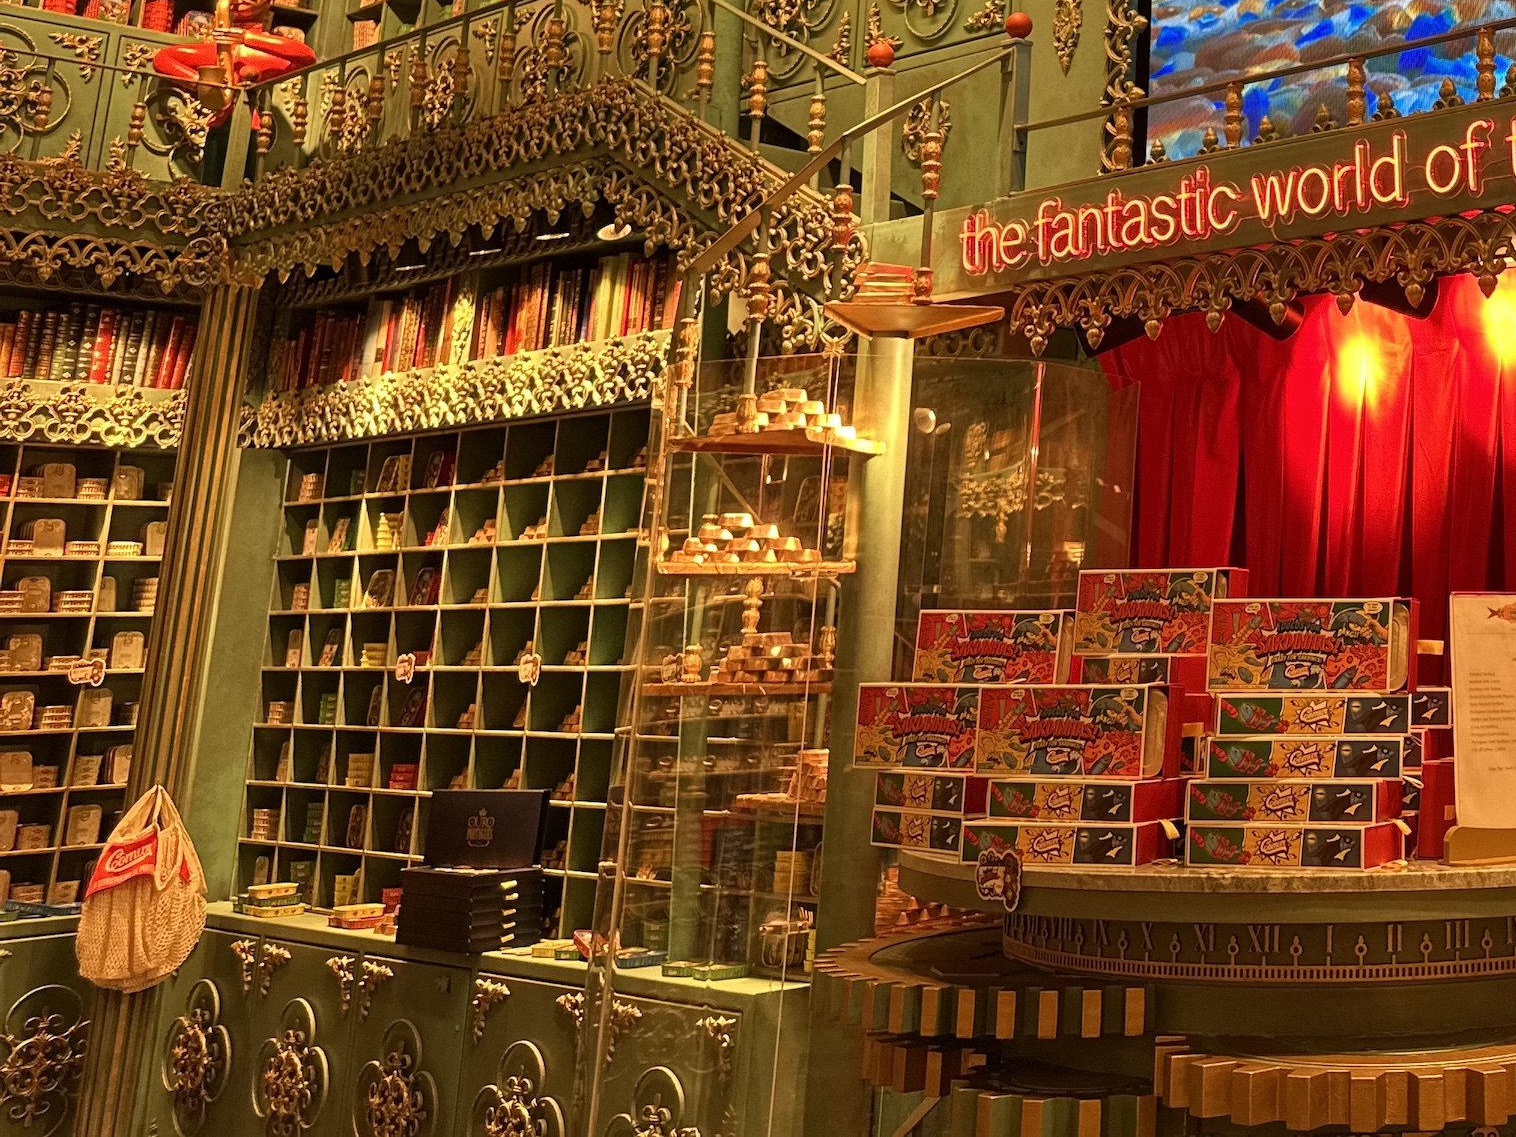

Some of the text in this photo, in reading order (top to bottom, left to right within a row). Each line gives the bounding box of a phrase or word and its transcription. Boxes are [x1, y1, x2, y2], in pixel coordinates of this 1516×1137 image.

[959, 209, 1028, 274] the
[1032, 168, 1241, 263] fantastic
[1251, 133, 1405, 221] world
[1425, 119, 1493, 194] of
[1246, 924, 1281, 954] XII
